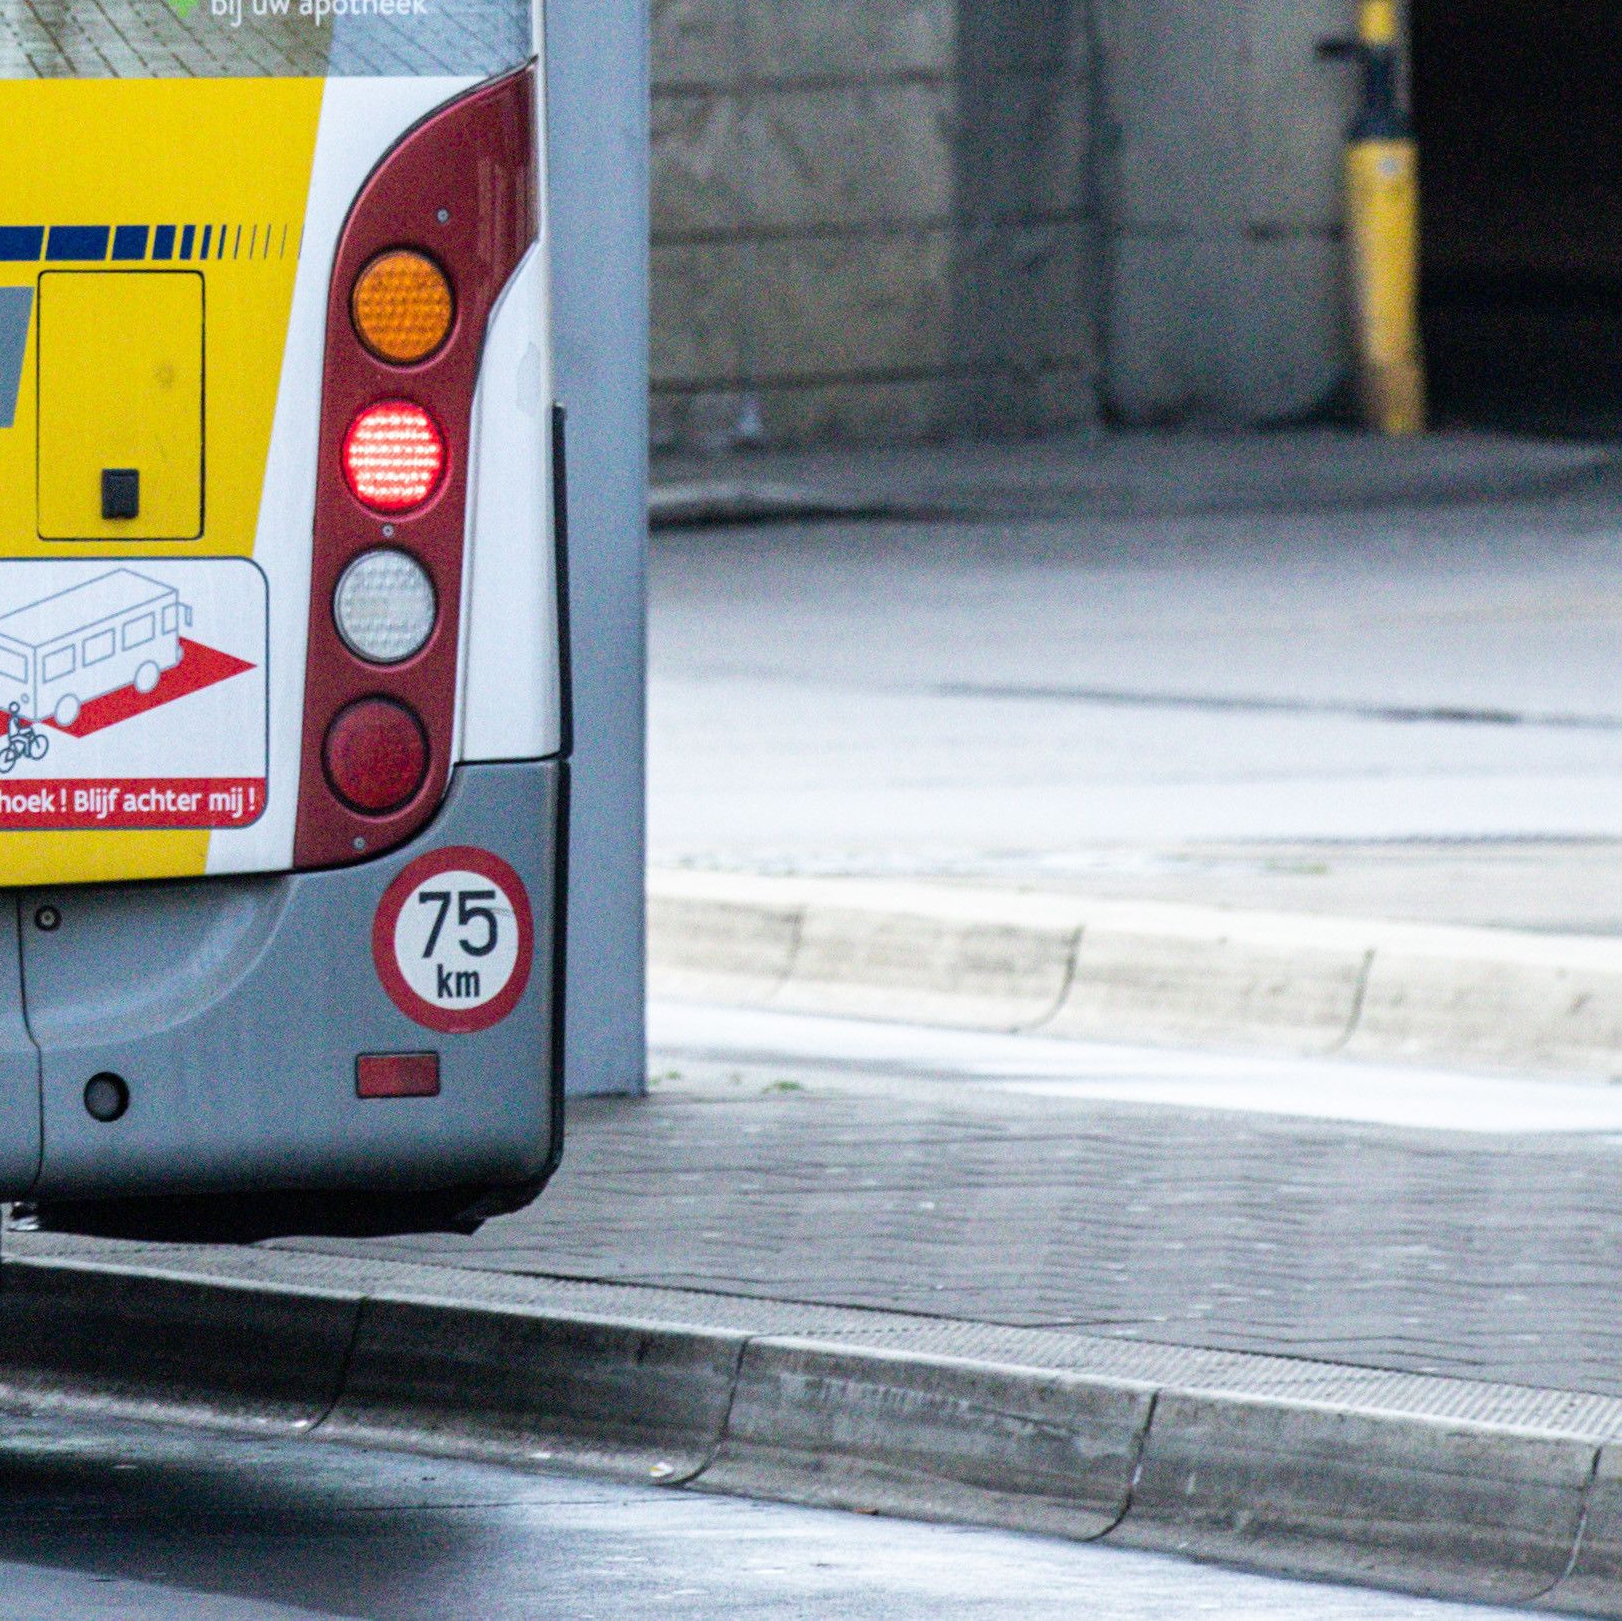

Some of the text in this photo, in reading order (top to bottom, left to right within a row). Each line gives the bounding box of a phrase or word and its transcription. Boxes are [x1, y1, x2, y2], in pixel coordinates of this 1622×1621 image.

[74, 787, 120, 819] Blijf
[122, 787, 202, 812] achter
[418, 890, 499, 958] 75
[436, 963, 481, 999] km
